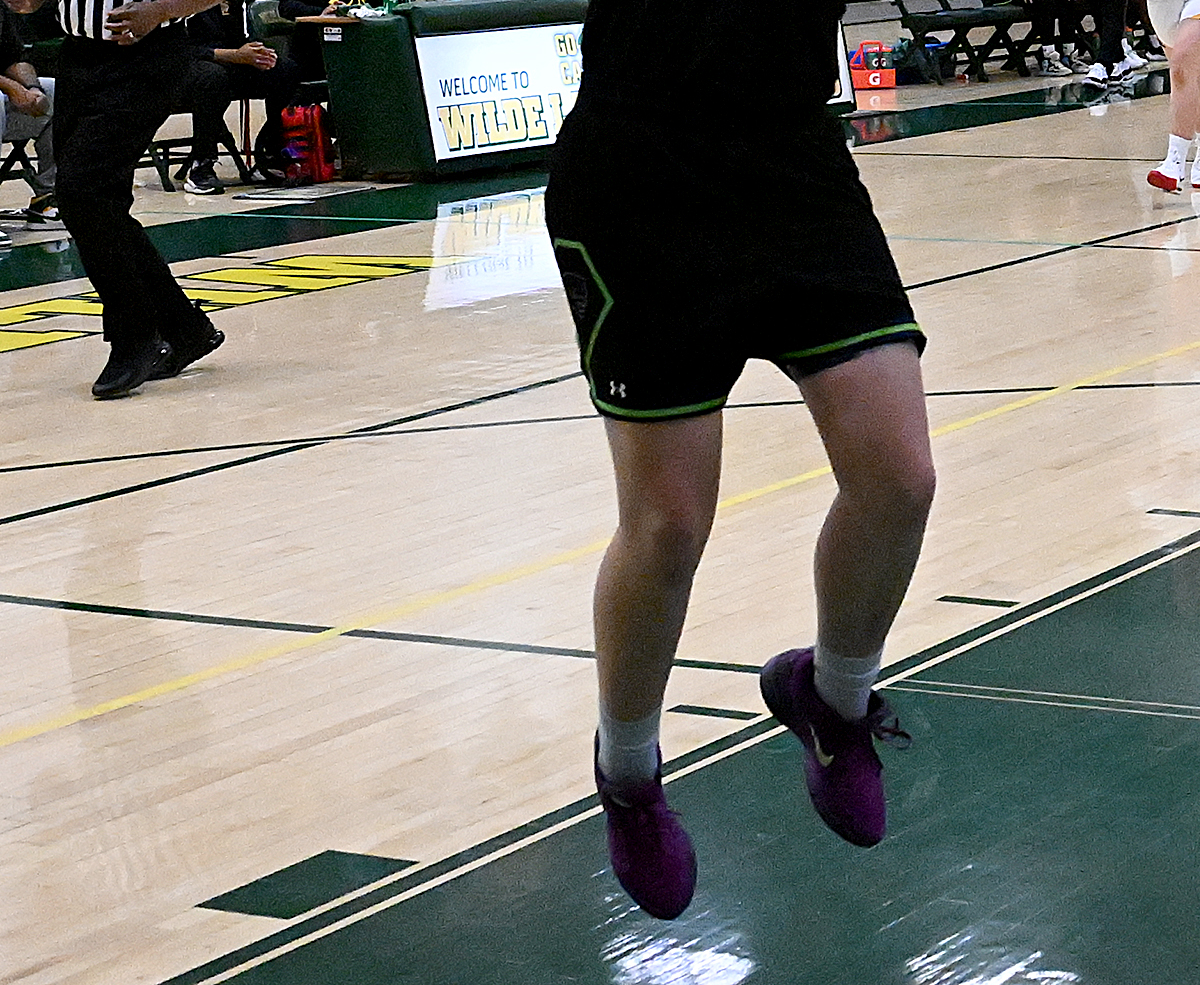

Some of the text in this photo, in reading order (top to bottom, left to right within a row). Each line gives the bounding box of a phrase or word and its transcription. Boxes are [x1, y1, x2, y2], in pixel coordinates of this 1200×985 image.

[554, 32, 578, 57] GO
[439, 70, 529, 98] WELCOME TO
[868, 72, 881, 86] G
[436, 94, 550, 152] WILDE
